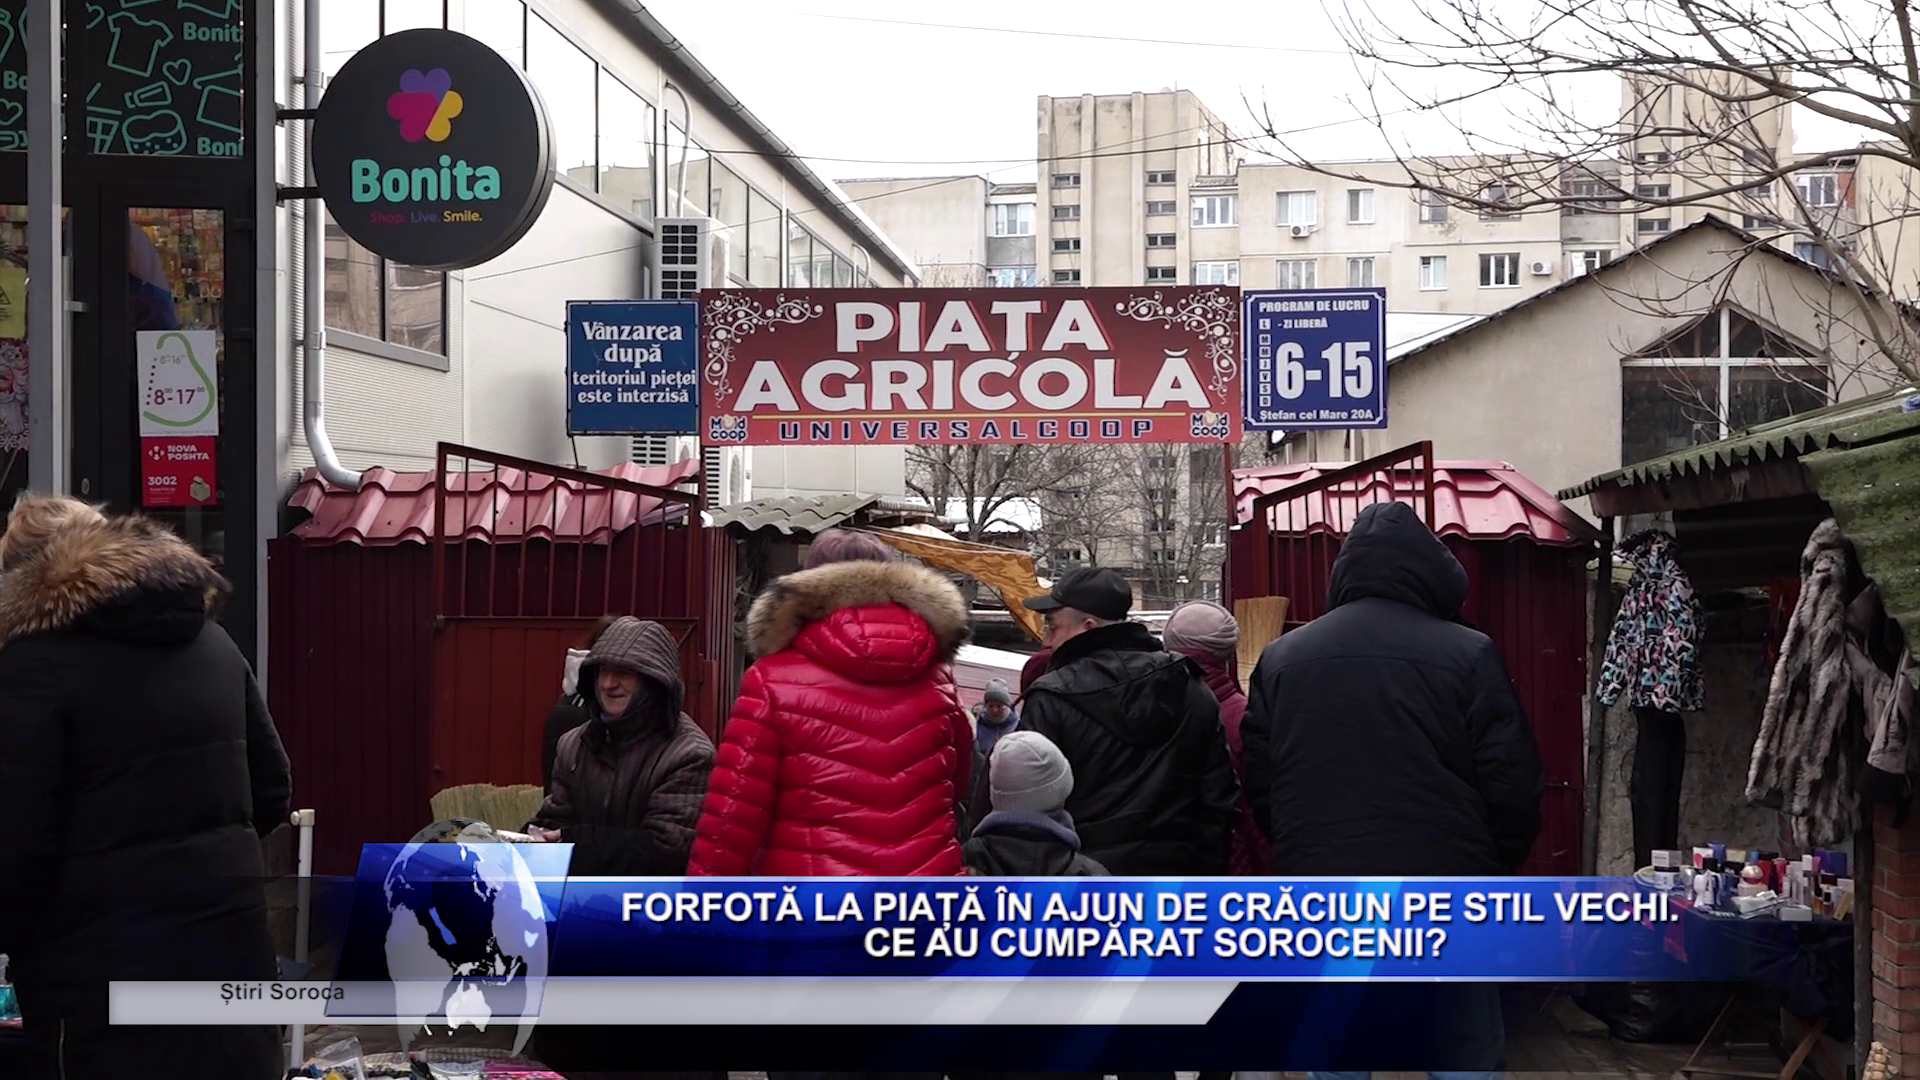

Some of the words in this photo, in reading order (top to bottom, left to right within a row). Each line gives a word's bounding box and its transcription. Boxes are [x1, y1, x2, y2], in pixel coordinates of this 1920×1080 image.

[352, 155, 500, 202] Bonita
[443, 210, 483, 222] Smile.
[1259, 301, 1315, 313] PROGRAM
[1316, 301, 1331, 311] DE
[1332, 300, 1370, 311] LUCRU
[836, 300, 1109, 360] PIAȚA
[1294, 317, 1328, 328] LIBERĂ
[582, 322, 682, 340] Vânzarea
[604, 343, 662, 369] după
[572, 369, 646, 386] teritoriul
[1276, 341, 1373, 399] 6-15
[733, 349, 1212, 412] AGRICOLĂ
[578, 389, 612, 403] este
[617, 387, 689, 403] interzisă
[1299, 410, 1317, 419] cel
[1319, 409, 1349, 419] Mare
[1350, 409, 1373, 419] 20A
[711, 430, 746, 442] coop
[781, 419, 1153, 443] UNIVERSALCOOP
[1192, 427, 1228, 438] coop
[147, 476, 178, 486] 3002
